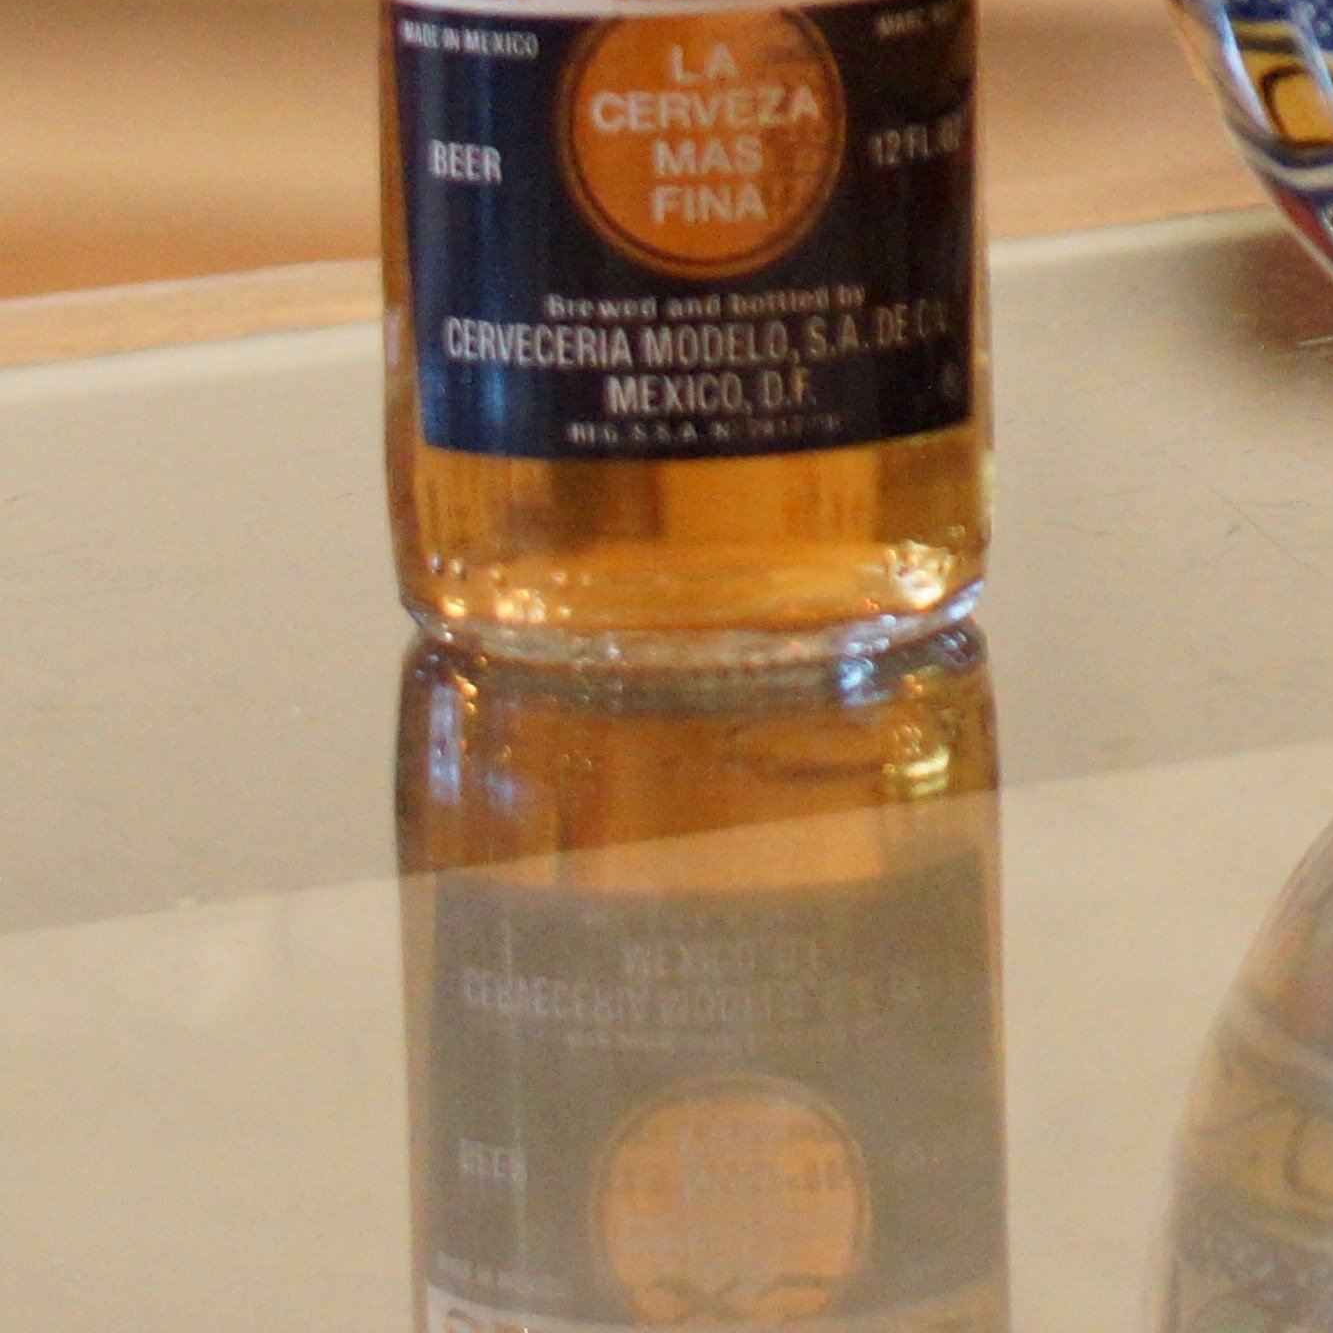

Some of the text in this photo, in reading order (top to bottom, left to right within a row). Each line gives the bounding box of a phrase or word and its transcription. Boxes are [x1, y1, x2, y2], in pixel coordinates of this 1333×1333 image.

[670, 42, 740, 83] LA
[588, 83, 822, 134] CERVEZA
[427, 139, 501, 184] BEER
[653, 134, 766, 176] MAS
[651, 181, 770, 229] FINA
[445, 315, 634, 369] CERVECERIA
